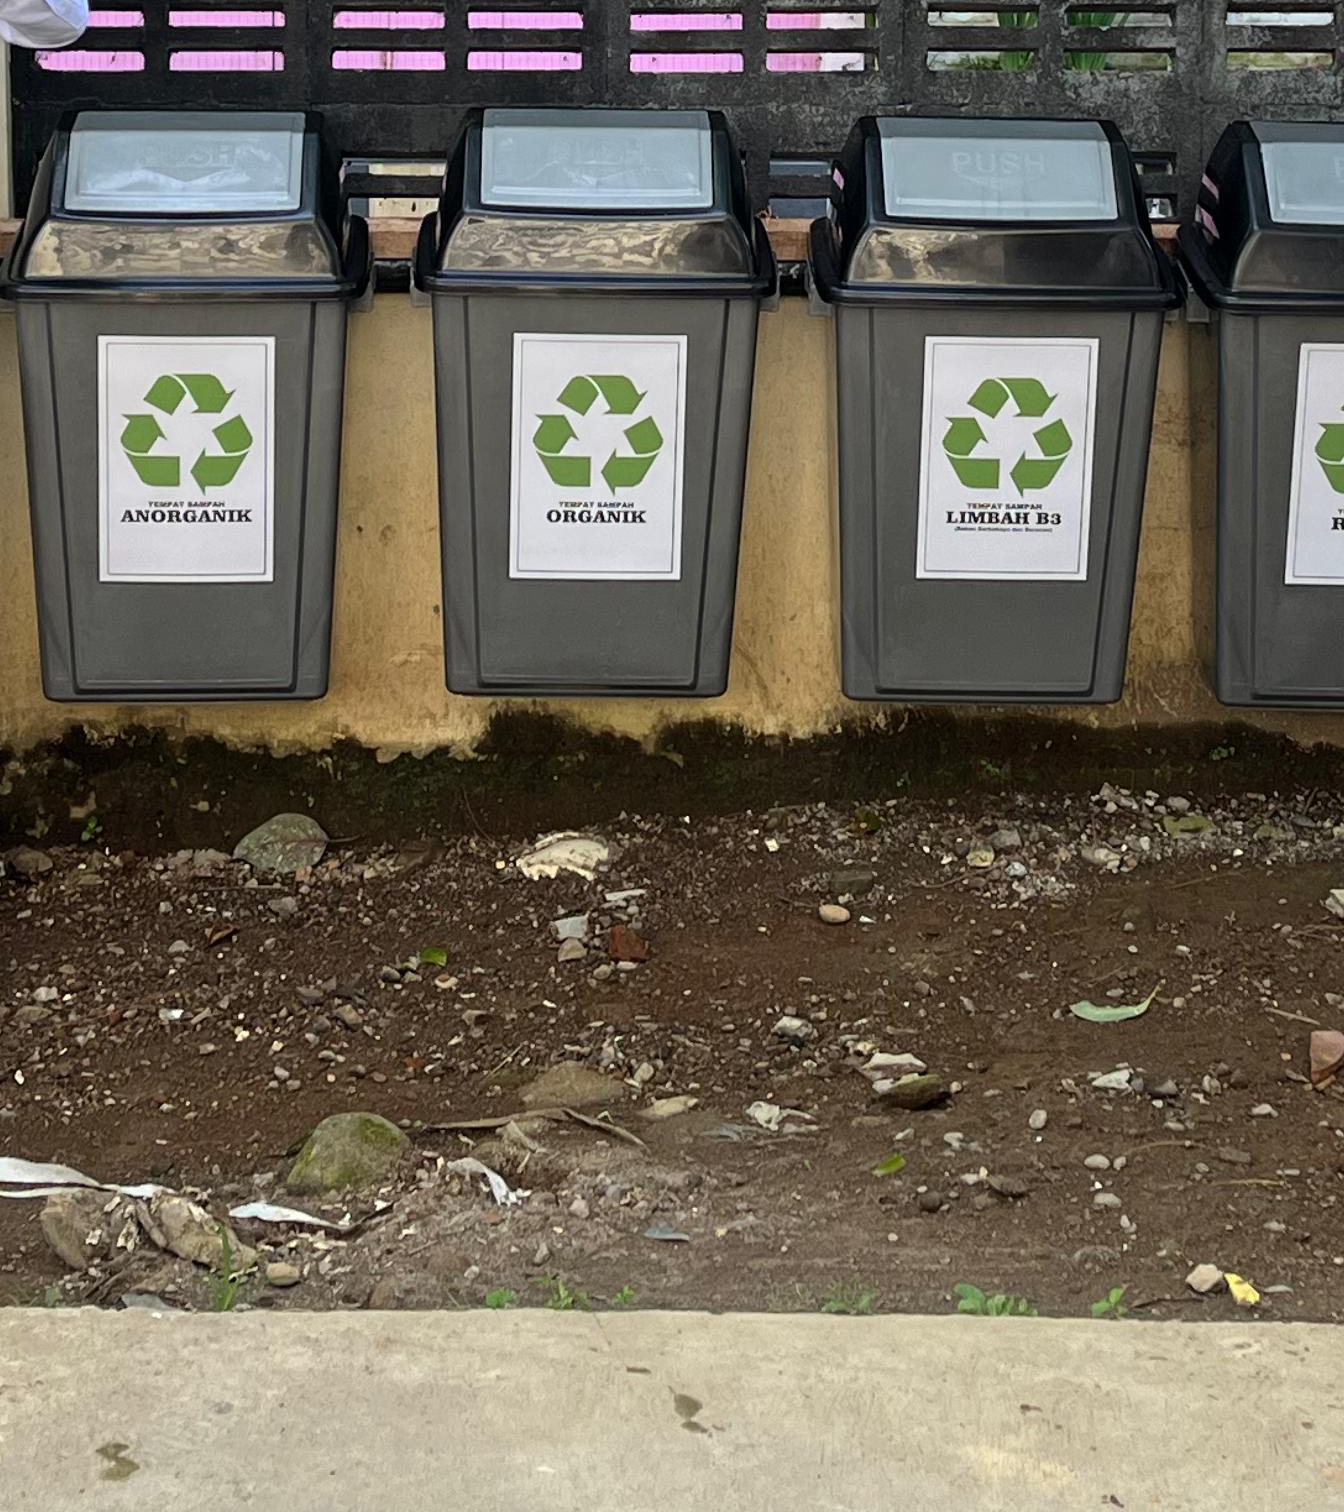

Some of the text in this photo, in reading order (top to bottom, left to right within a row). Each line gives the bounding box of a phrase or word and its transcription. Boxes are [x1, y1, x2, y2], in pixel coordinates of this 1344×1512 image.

[953, 151, 1046, 175] PUSH
[121, 509, 253, 523] ANORGANIK
[546, 509, 647, 524] ORGANIK
[946, 511, 1062, 525] LIMBAH B3
